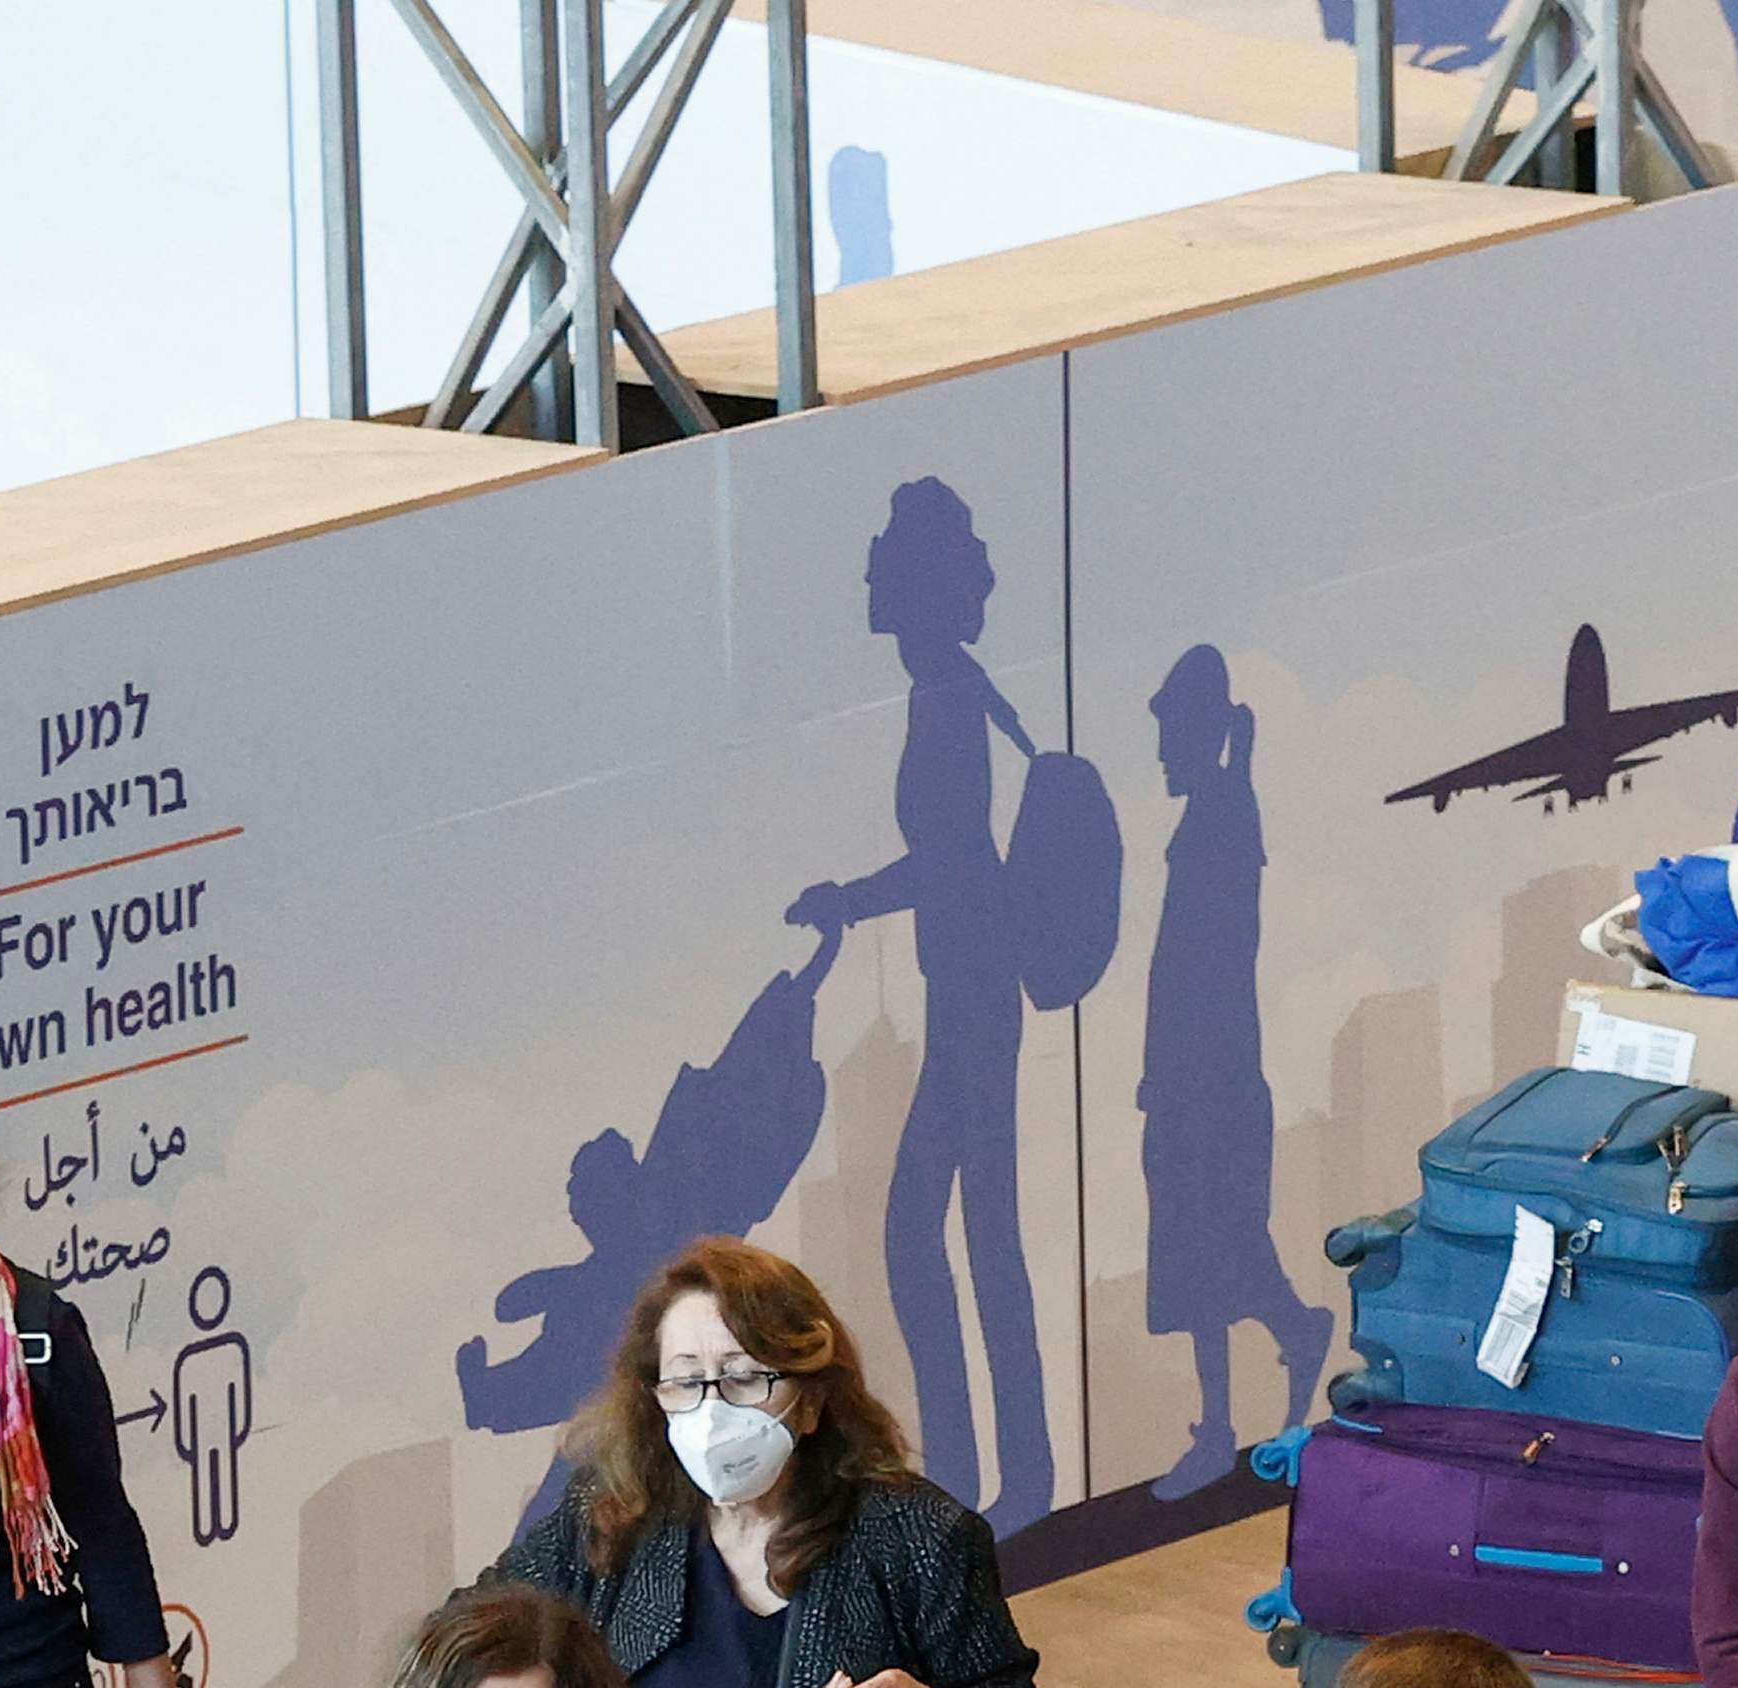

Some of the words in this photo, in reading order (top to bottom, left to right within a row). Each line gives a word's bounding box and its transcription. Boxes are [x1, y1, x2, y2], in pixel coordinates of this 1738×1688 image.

[38, 682, 150, 777] למען
[5, 766, 189, 865] בריאותך
[91, 879, 207, 971] your
[84, 953, 238, 1047] health
[22, 1100, 102, 1211] أجل
[128, 1121, 187, 1188] من
